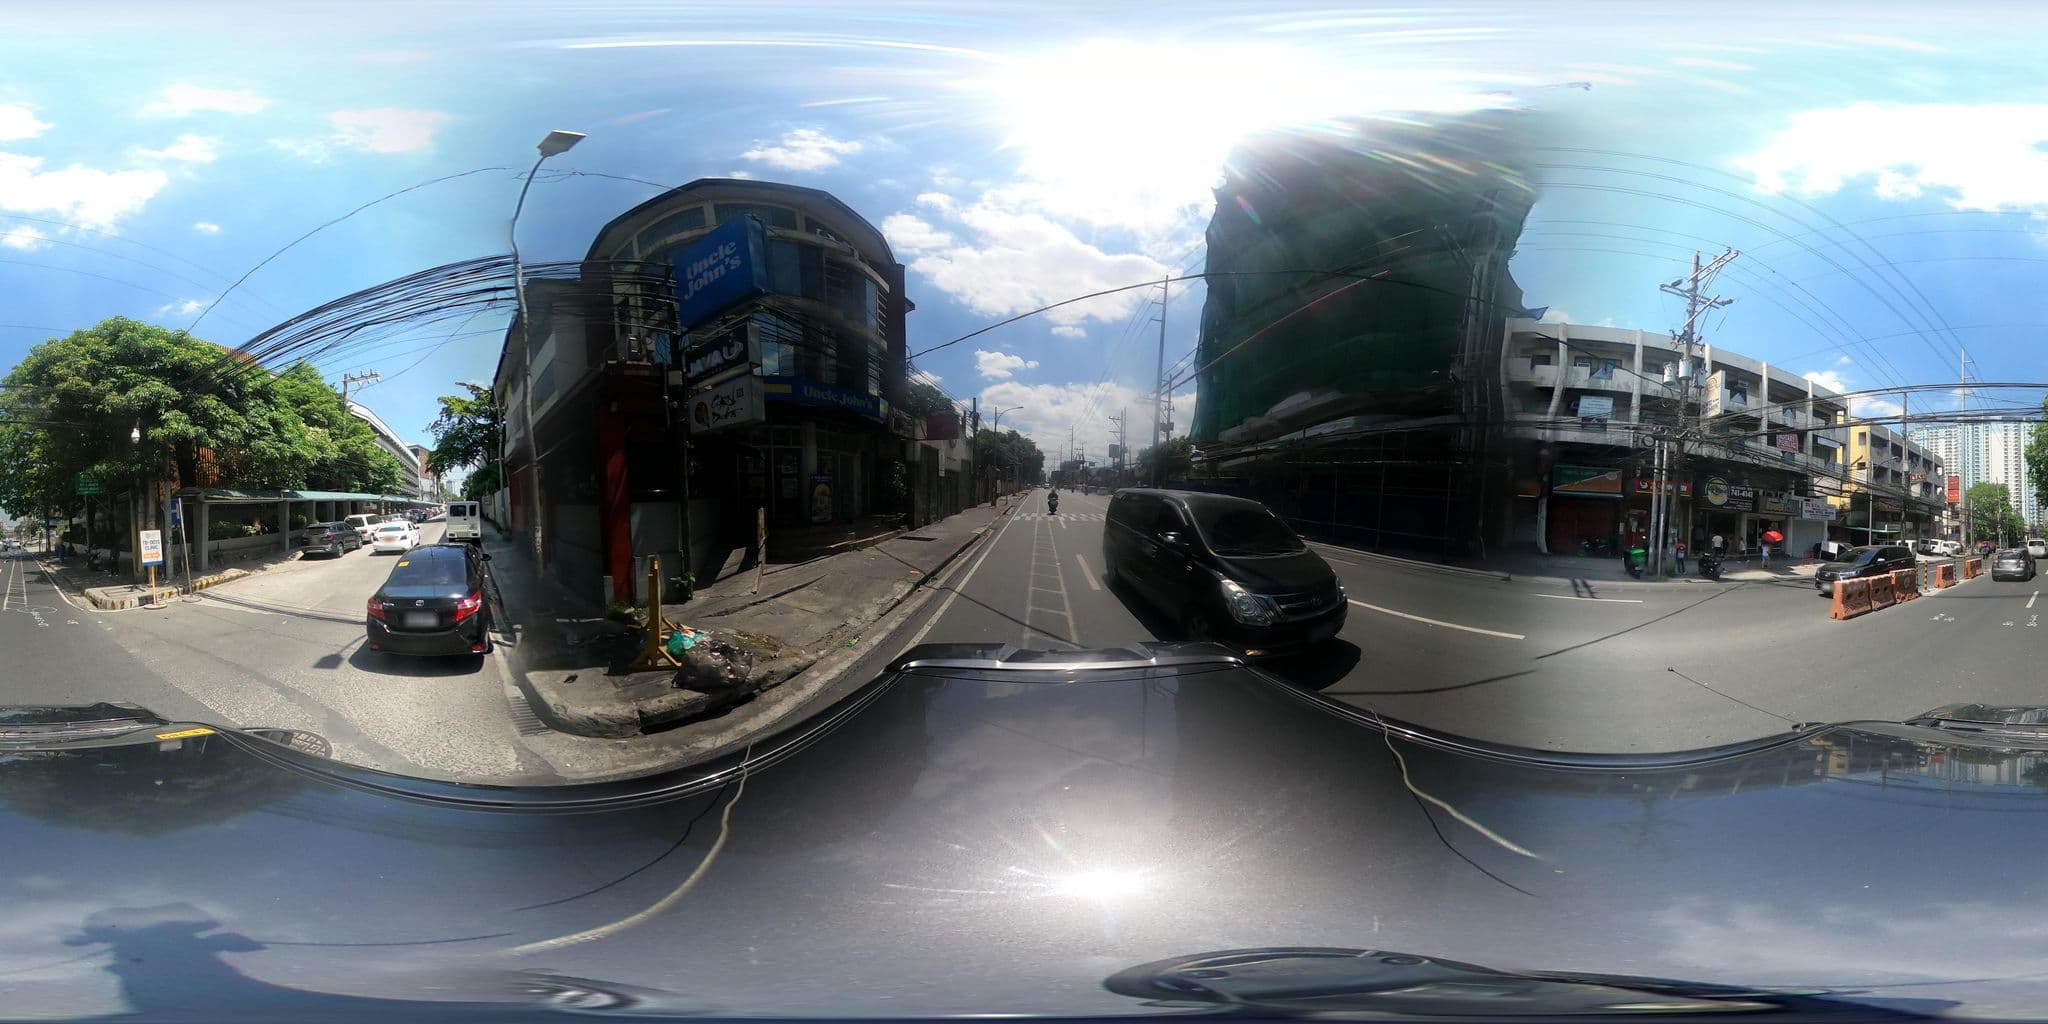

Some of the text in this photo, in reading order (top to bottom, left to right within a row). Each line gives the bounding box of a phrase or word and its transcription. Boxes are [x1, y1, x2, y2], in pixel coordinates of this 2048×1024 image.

[684, 255, 742, 300] John's
[685, 240, 737, 280] Uncle
[802, 384, 873, 410] Uncle John's
